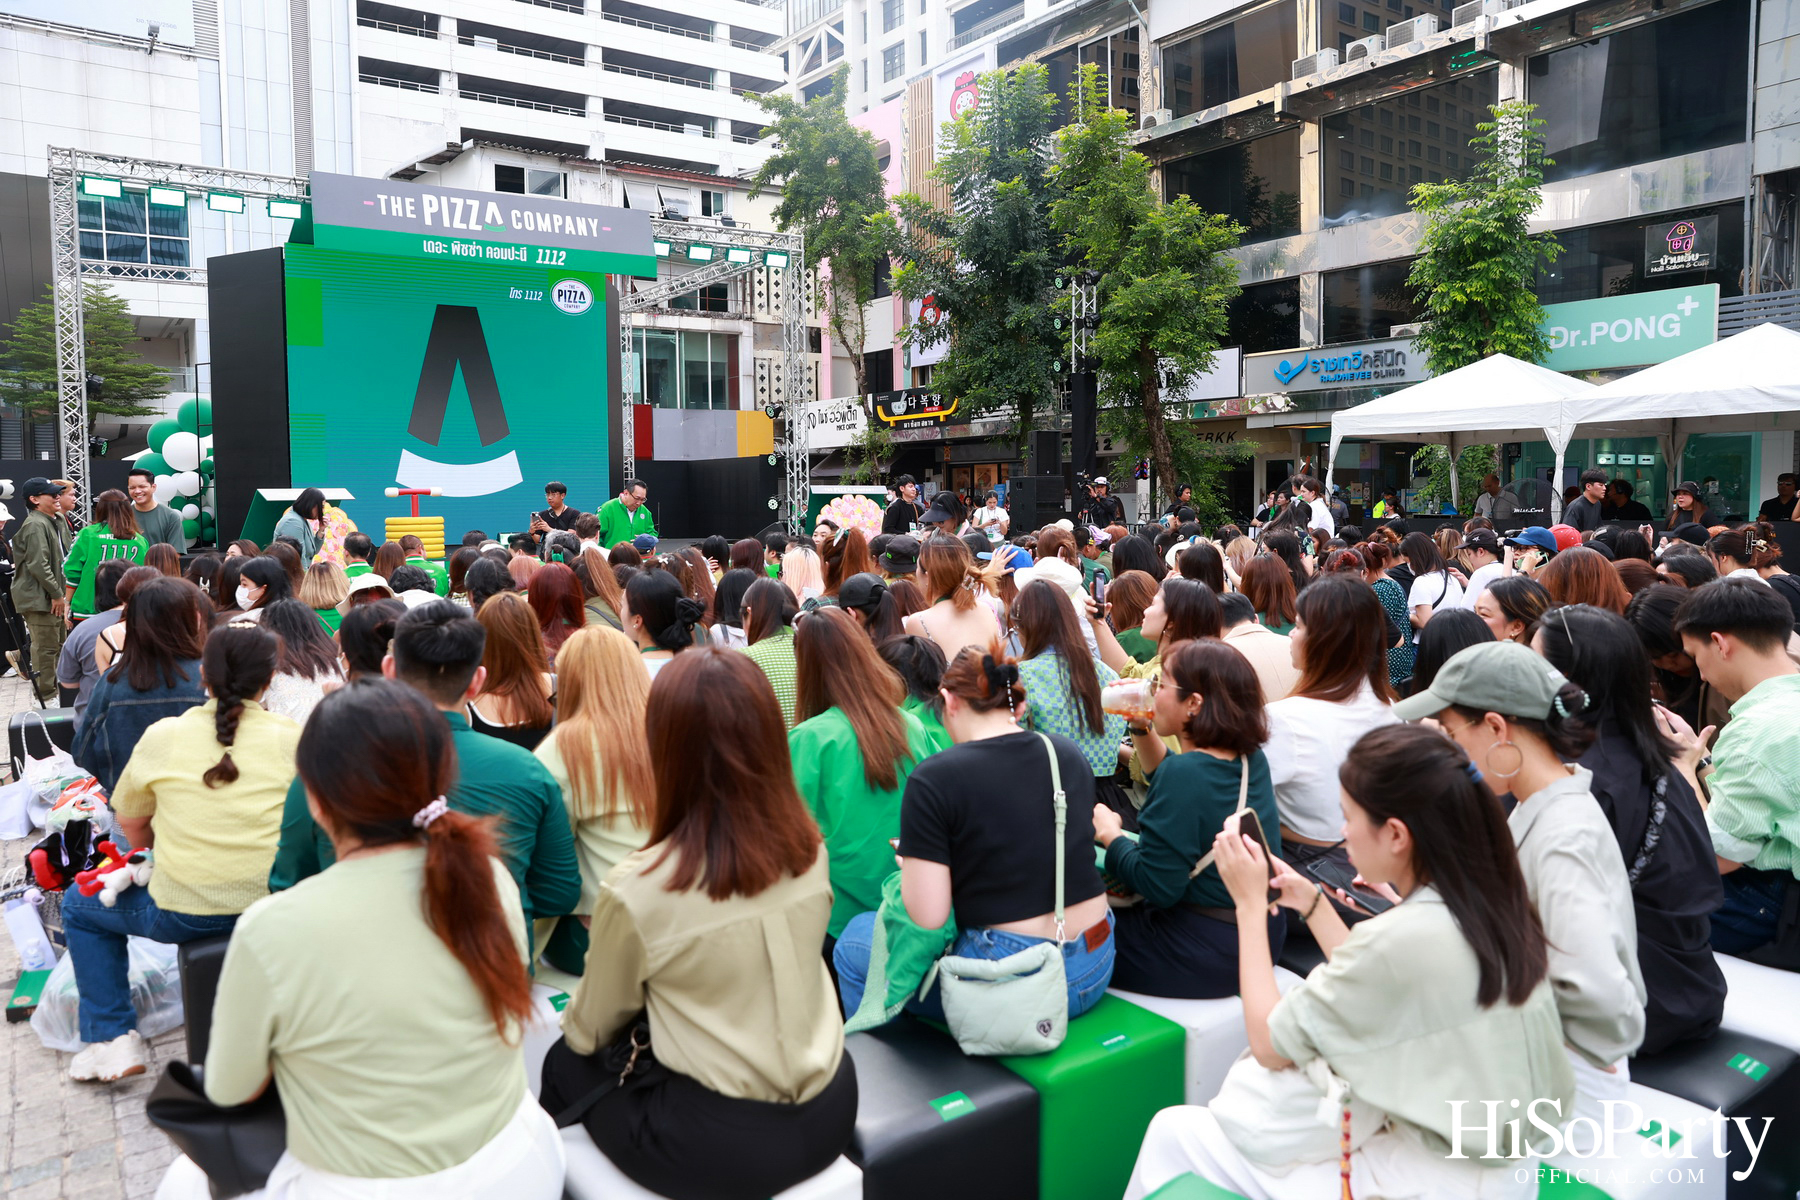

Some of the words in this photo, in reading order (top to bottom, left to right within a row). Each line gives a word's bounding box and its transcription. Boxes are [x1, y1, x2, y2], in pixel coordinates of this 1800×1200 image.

[377, 194, 416, 218] THE
[422, 194, 506, 232] PIZZA
[511, 209, 598, 237] COMPANY
[423, 240, 448, 254] เดอะ
[451, 241, 483, 258] พิซซ่า
[486, 246, 527, 262] คอมปะนี
[536, 248, 566, 266] 1112
[524, 290, 543, 301] 1112
[558, 289, 586, 304] PIZZA
[1320, 371, 1371, 383] RAJDHEVEE
[1373, 368, 1405, 379] CLINIC
